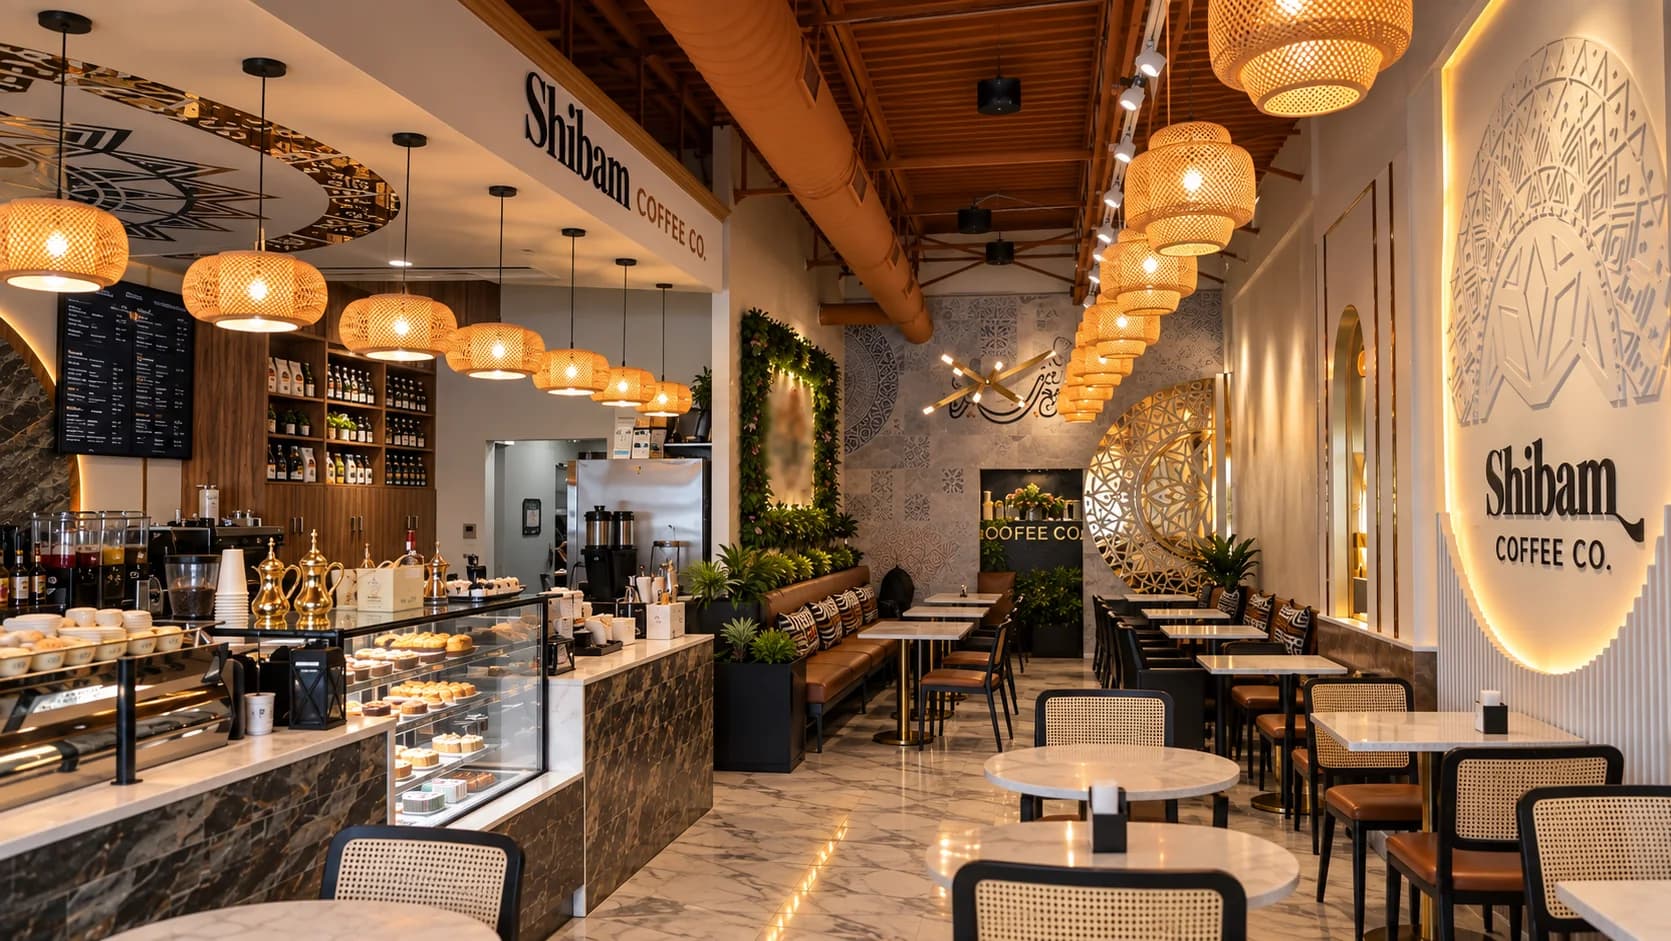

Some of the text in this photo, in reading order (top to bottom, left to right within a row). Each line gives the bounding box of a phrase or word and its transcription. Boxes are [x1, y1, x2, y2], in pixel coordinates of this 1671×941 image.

[525, 71, 707, 262] Shibam COFFEE CO.
[1485, 437, 1645, 543] Shibam
[1496, 535, 1612, 571] COFFEE CO.
